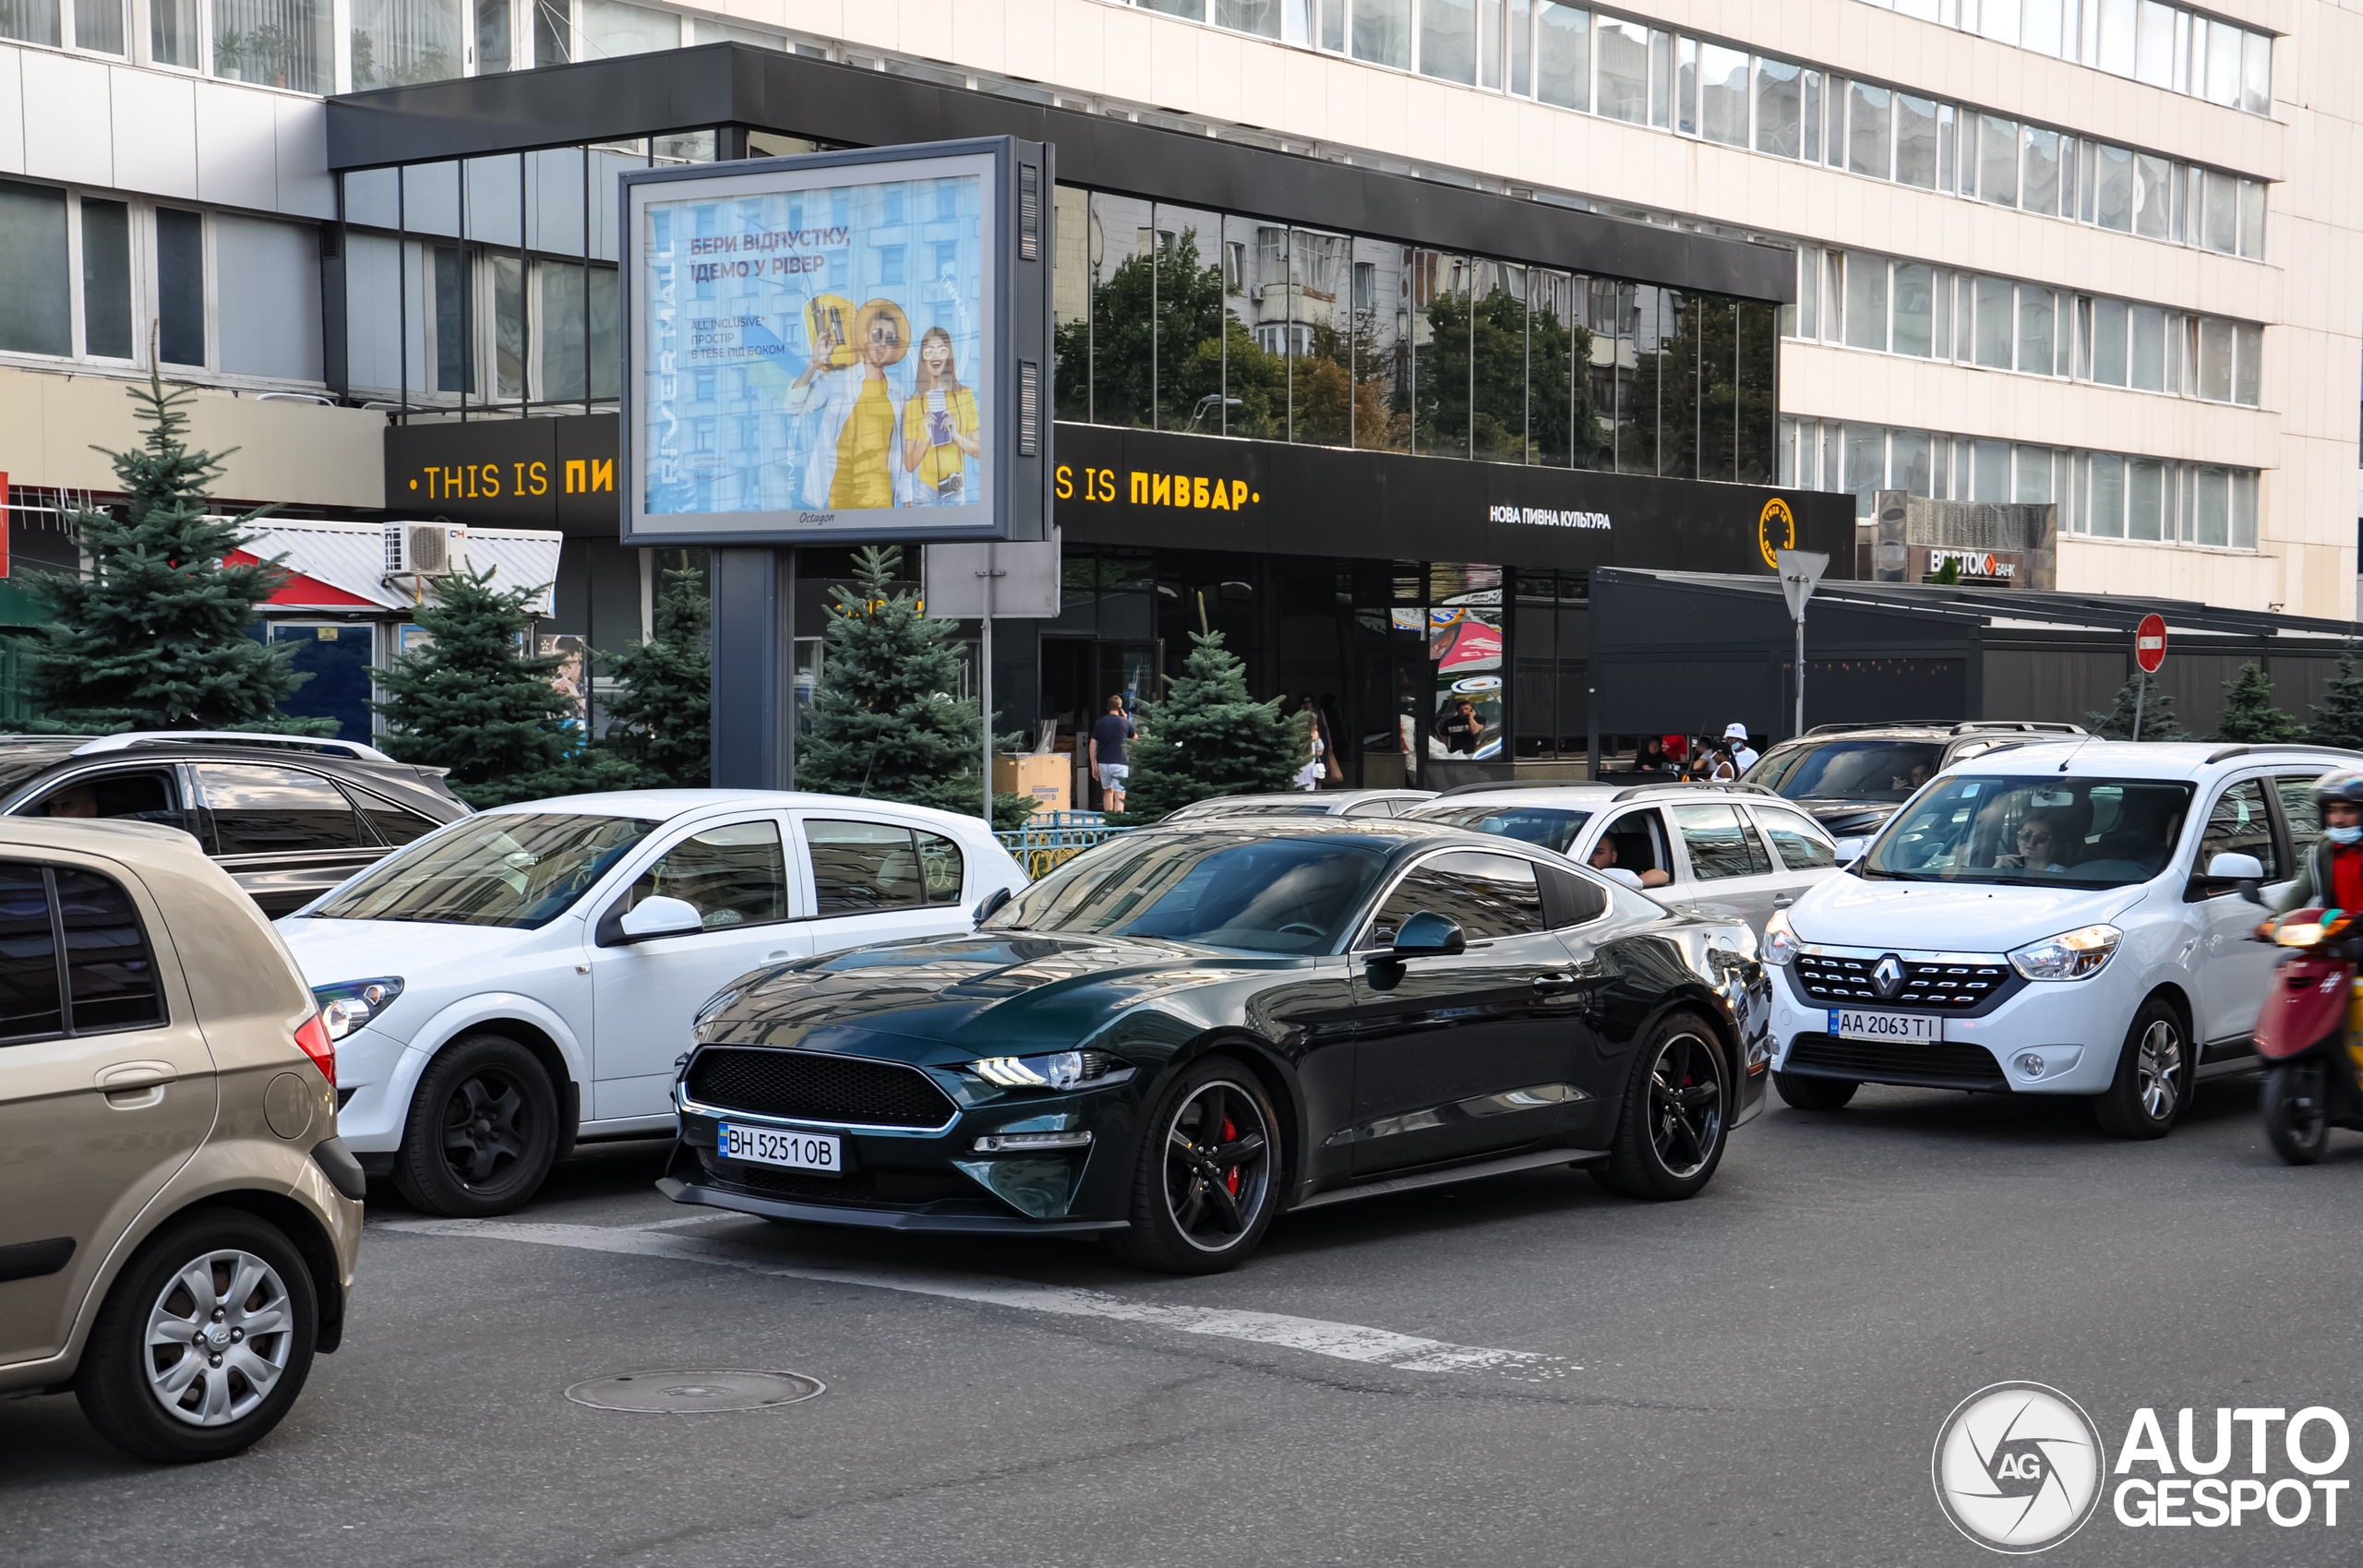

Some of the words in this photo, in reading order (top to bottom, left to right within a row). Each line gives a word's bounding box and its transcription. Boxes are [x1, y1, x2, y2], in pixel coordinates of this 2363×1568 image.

[690, 235, 737, 255] БЕРИ
[743, 226, 851, 253] ВІДПУСТКУ,
[690, 259, 750, 283] ЇДЕМО
[754, 259, 766, 277] У
[772, 255, 825, 276] РІВЕР
[659, 240, 678, 337] MALL
[690, 321, 709, 330] ALL
[690, 333, 735, 344] ПРОСТІР
[691, 350, 698, 359] В
[701, 347, 725, 358] ТЕБЕ
[727, 347, 745, 358] ПІД
[748, 344, 785, 355] БОКОМ
[661, 350, 678, 484] RIVER
[424, 463, 499, 499] THIS
[514, 461, 547, 496] IS
[1085, 467, 1115, 502] IS
[1131, 471, 1248, 511] ПИВБАР
[798, 511, 835, 526] Octagon
[1490, 505, 1521, 524] НОВА
[1522, 508, 1559, 526] ПИВНА
[1560, 510, 1612, 530] КУЛЬТУРА
[1995, 562, 2016, 577] БАНК
[1841, 1013, 1865, 1032] AA
[1868, 1016, 1908, 1035] 2063
[719, 1144, 727, 1153] UA
[729, 1129, 753, 1156] BH
[759, 1133, 798, 1162] 5251
[805, 1139, 832, 1166] OB
